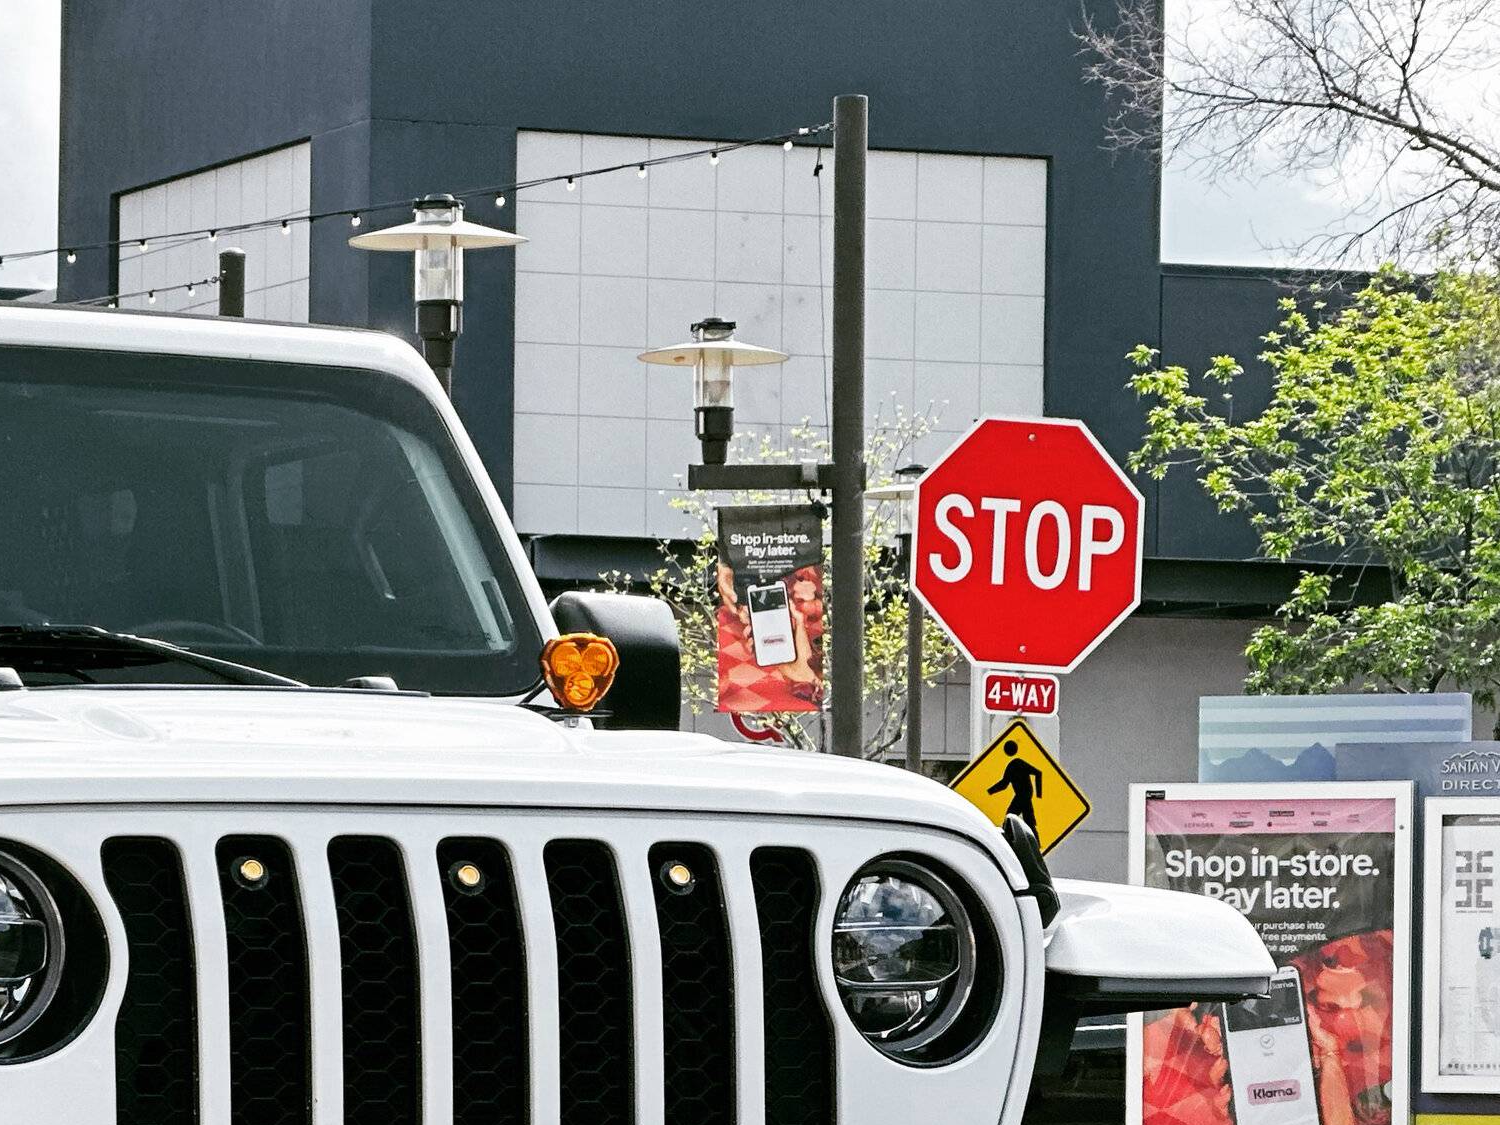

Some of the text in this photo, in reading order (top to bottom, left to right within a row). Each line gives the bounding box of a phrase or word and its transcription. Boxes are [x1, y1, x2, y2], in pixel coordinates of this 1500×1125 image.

[730, 533, 811, 547] Shop in-store.
[744, 545, 797, 558] Pay later.
[928, 492, 1126, 592] STOP
[988, 681, 1053, 708] 4-WAY
[1165, 847, 1380, 883] Shop in-store.
[1204, 880, 1341, 915] Pay later.
[1263, 921, 1306, 931] purchase
[1306, 921, 1326, 930] into
